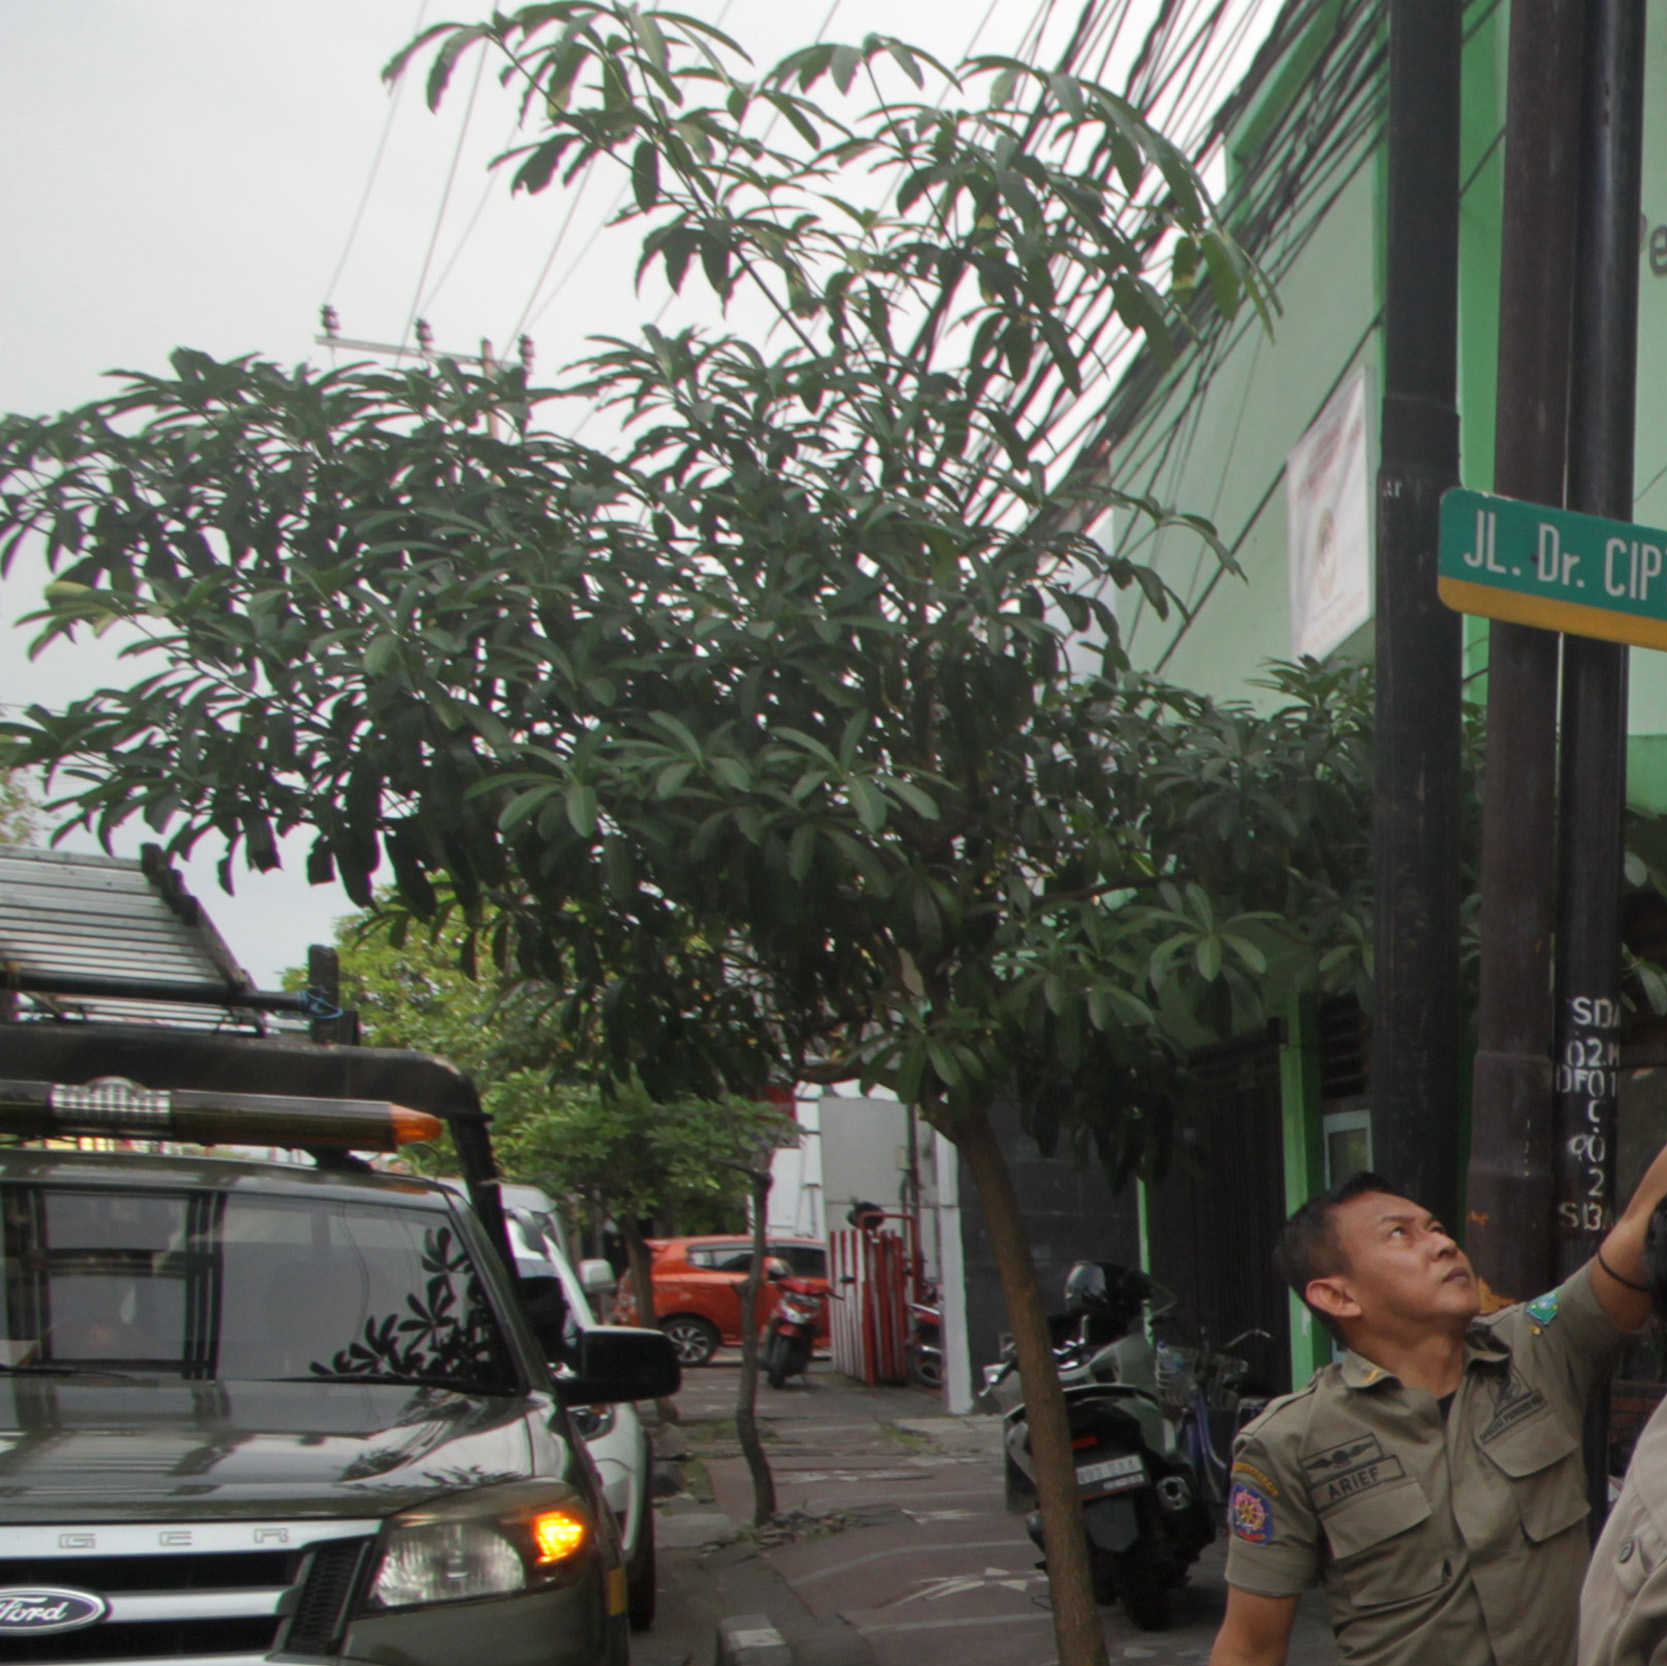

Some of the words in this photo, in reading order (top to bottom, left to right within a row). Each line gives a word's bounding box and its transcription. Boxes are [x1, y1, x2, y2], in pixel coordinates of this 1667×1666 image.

[1464, 510, 1521, 576] JL.
[1537, 524, 1585, 588] Dr.
[1328, 1466, 1380, 1499] ARIEF
[0, 1597, 70, 1622] Ford
